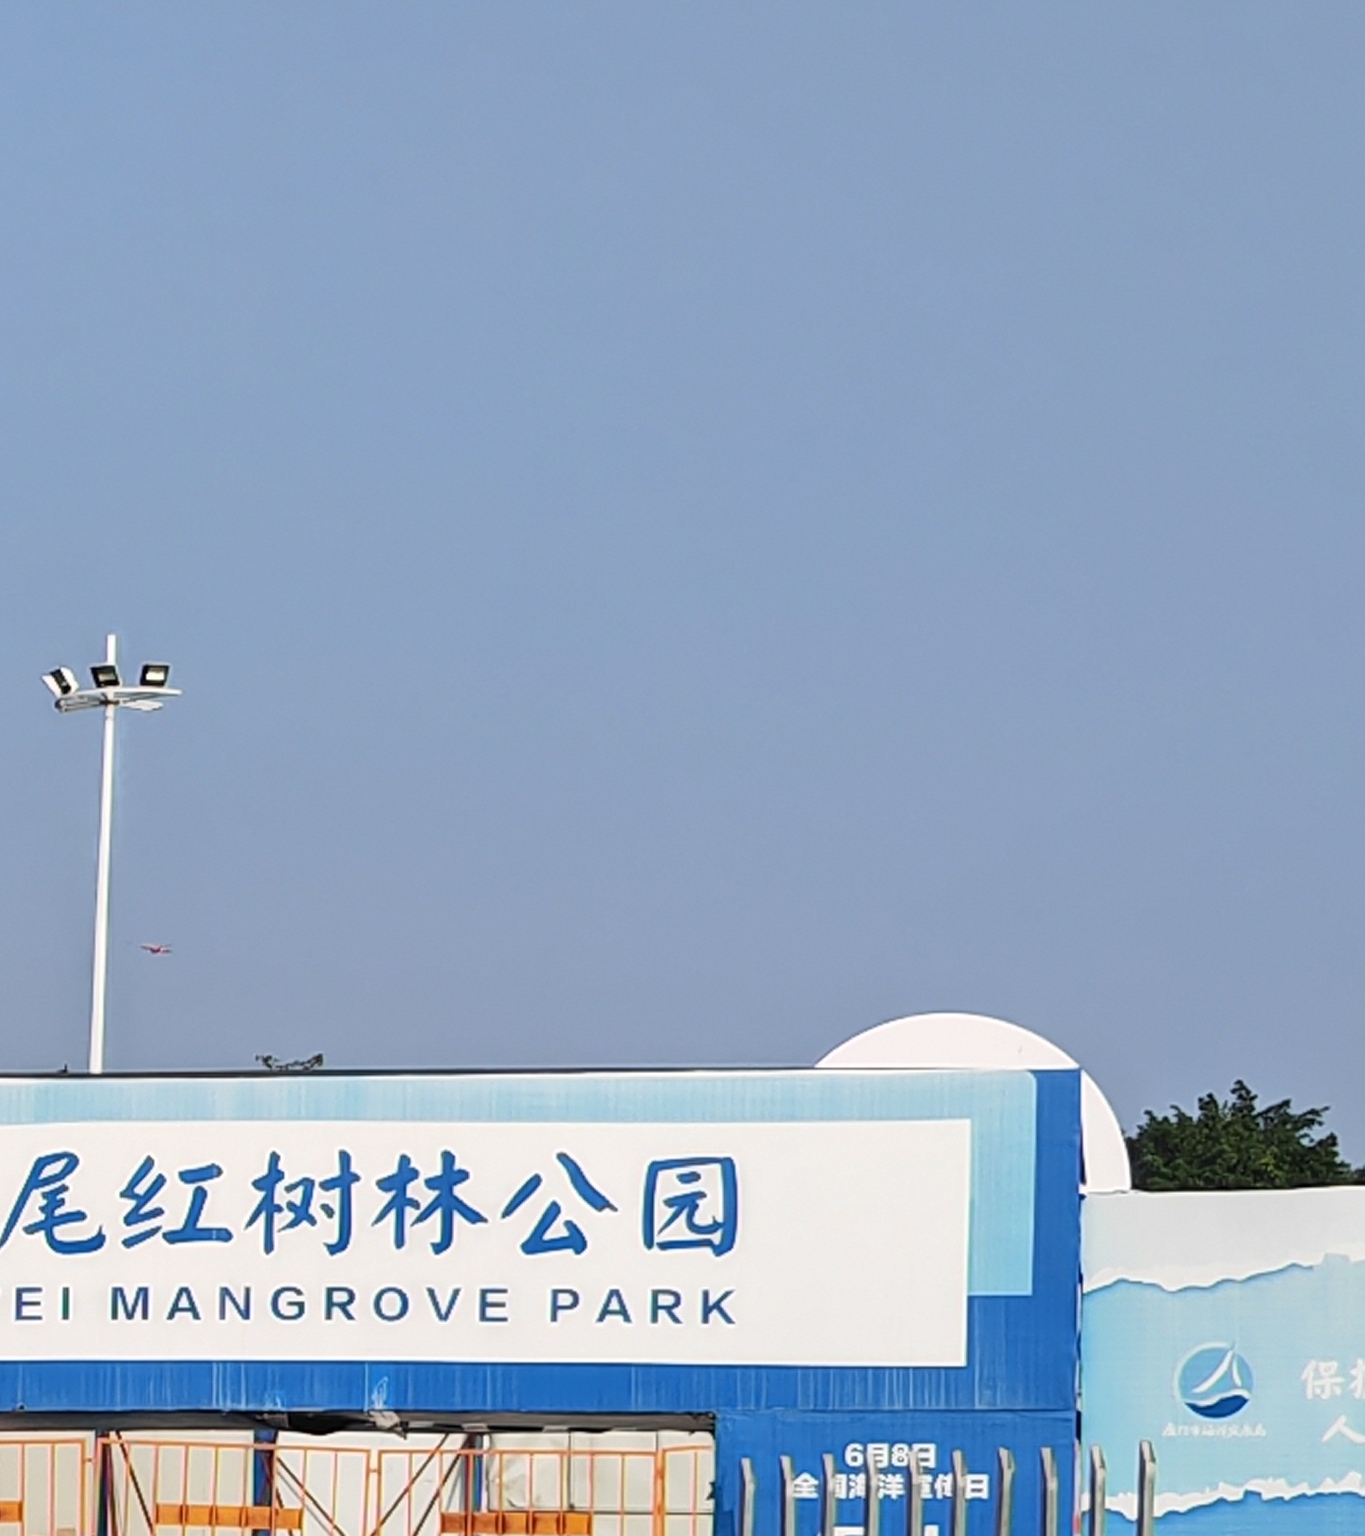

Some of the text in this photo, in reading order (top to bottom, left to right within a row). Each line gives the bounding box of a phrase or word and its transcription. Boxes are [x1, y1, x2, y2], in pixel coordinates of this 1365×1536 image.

[110, 1285, 510, 1323] MANGROVE
[549, 1287, 737, 1325] PARK
[844, 1442, 937, 1468] 6月8日
